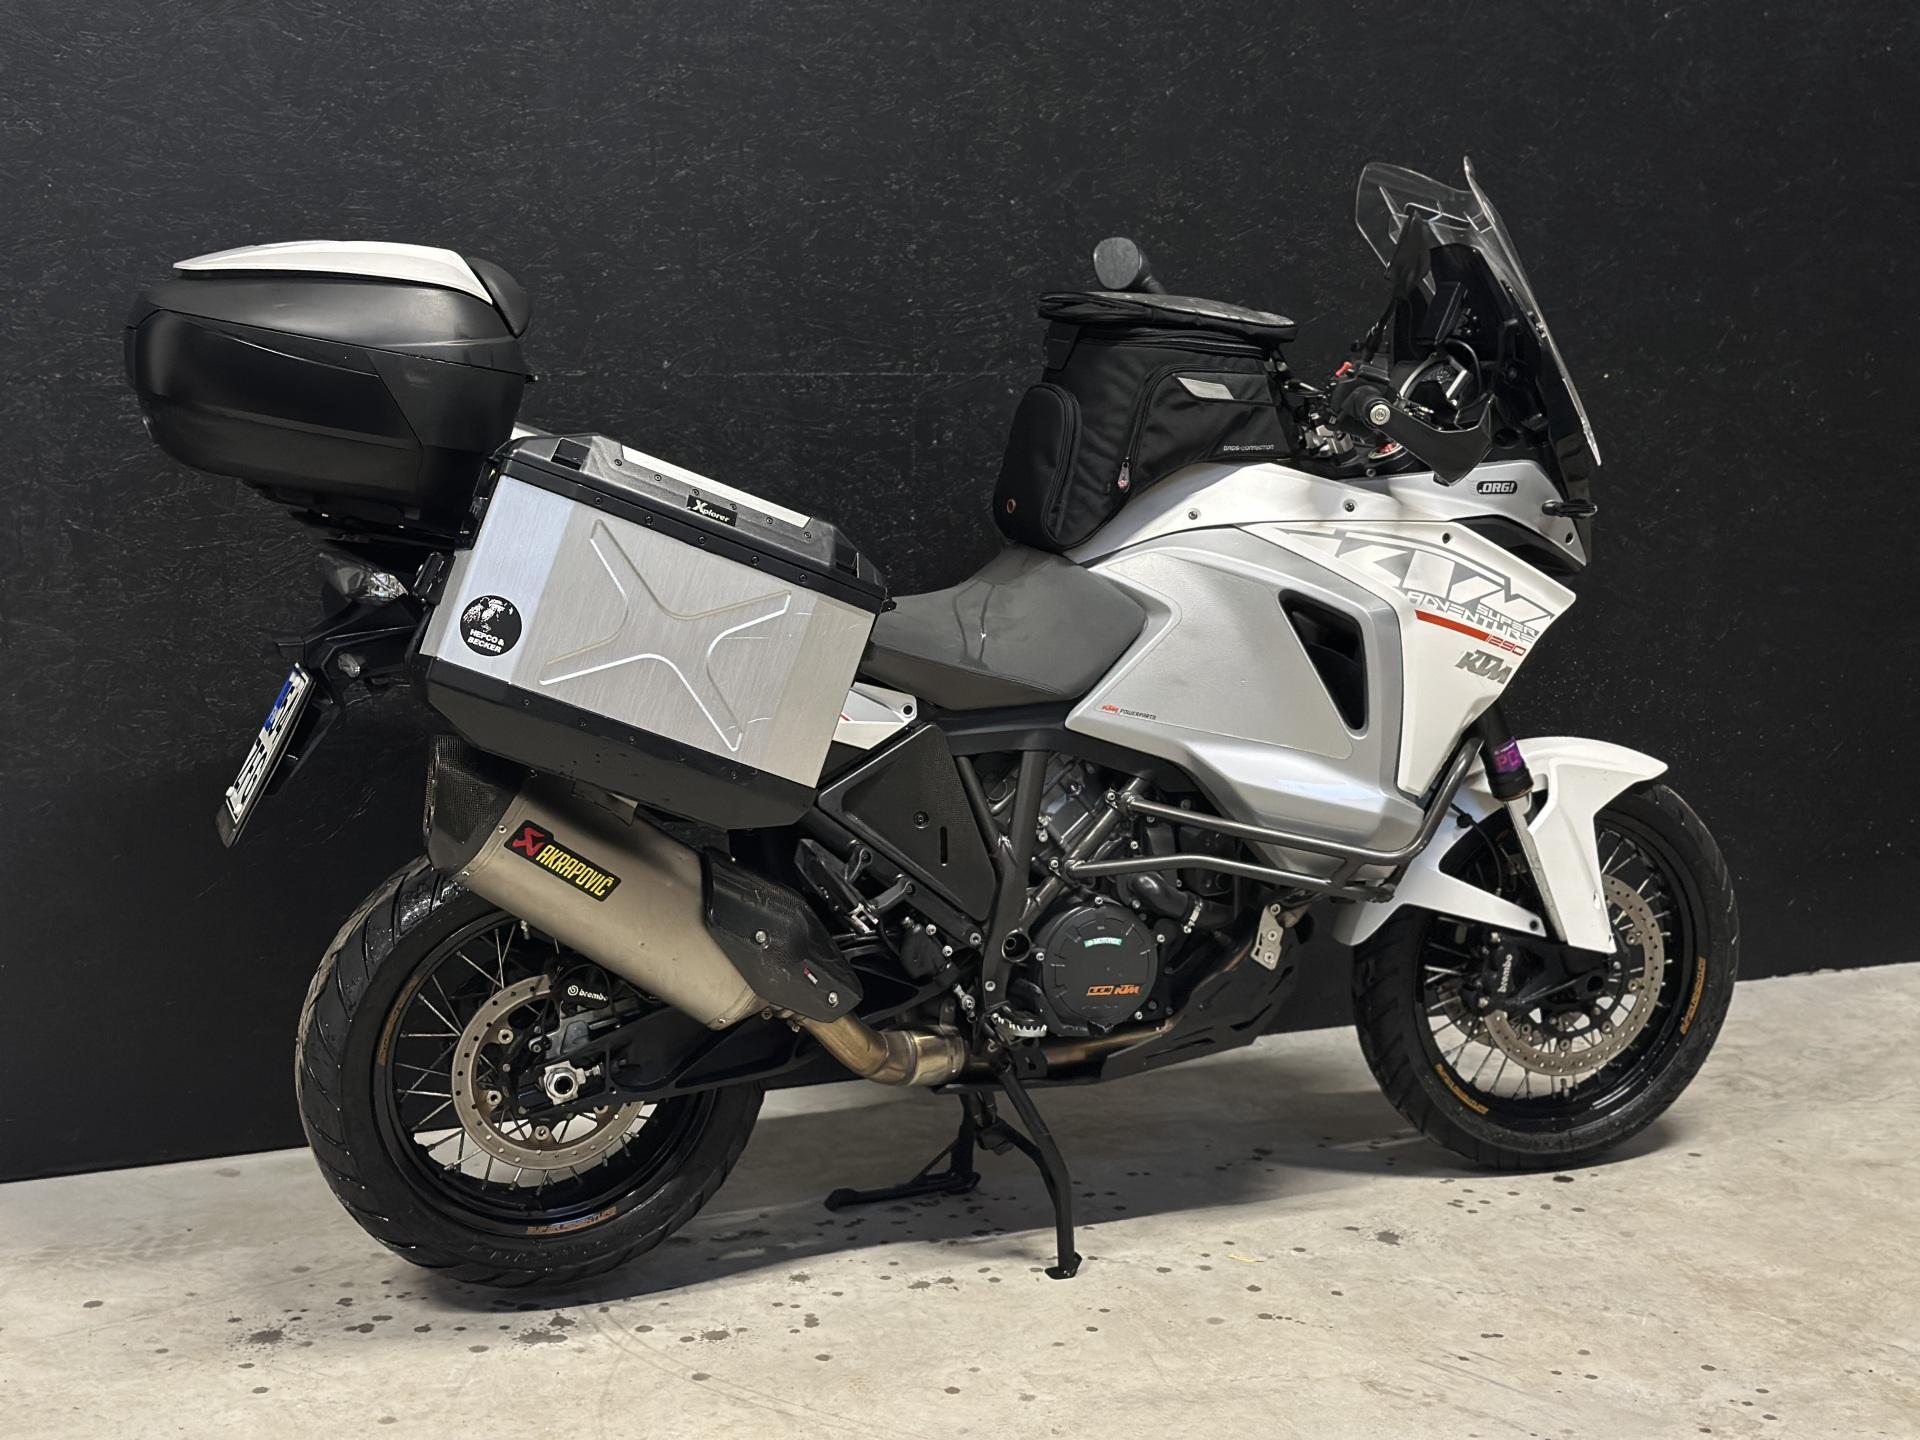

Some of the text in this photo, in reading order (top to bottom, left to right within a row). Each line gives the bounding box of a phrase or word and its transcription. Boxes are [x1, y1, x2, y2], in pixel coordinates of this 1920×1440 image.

[692, 499, 730, 522] Xplorer
[1405, 590, 1537, 645] ADVENTURE
[1476, 602, 1540, 638] SUPER
[467, 636, 503, 653] BECKER
[470, 628, 499, 644] HEPCO
[1454, 649, 1513, 685] KTM
[1496, 953, 1513, 993] brembo
[578, 988, 609, 1002] brembo
